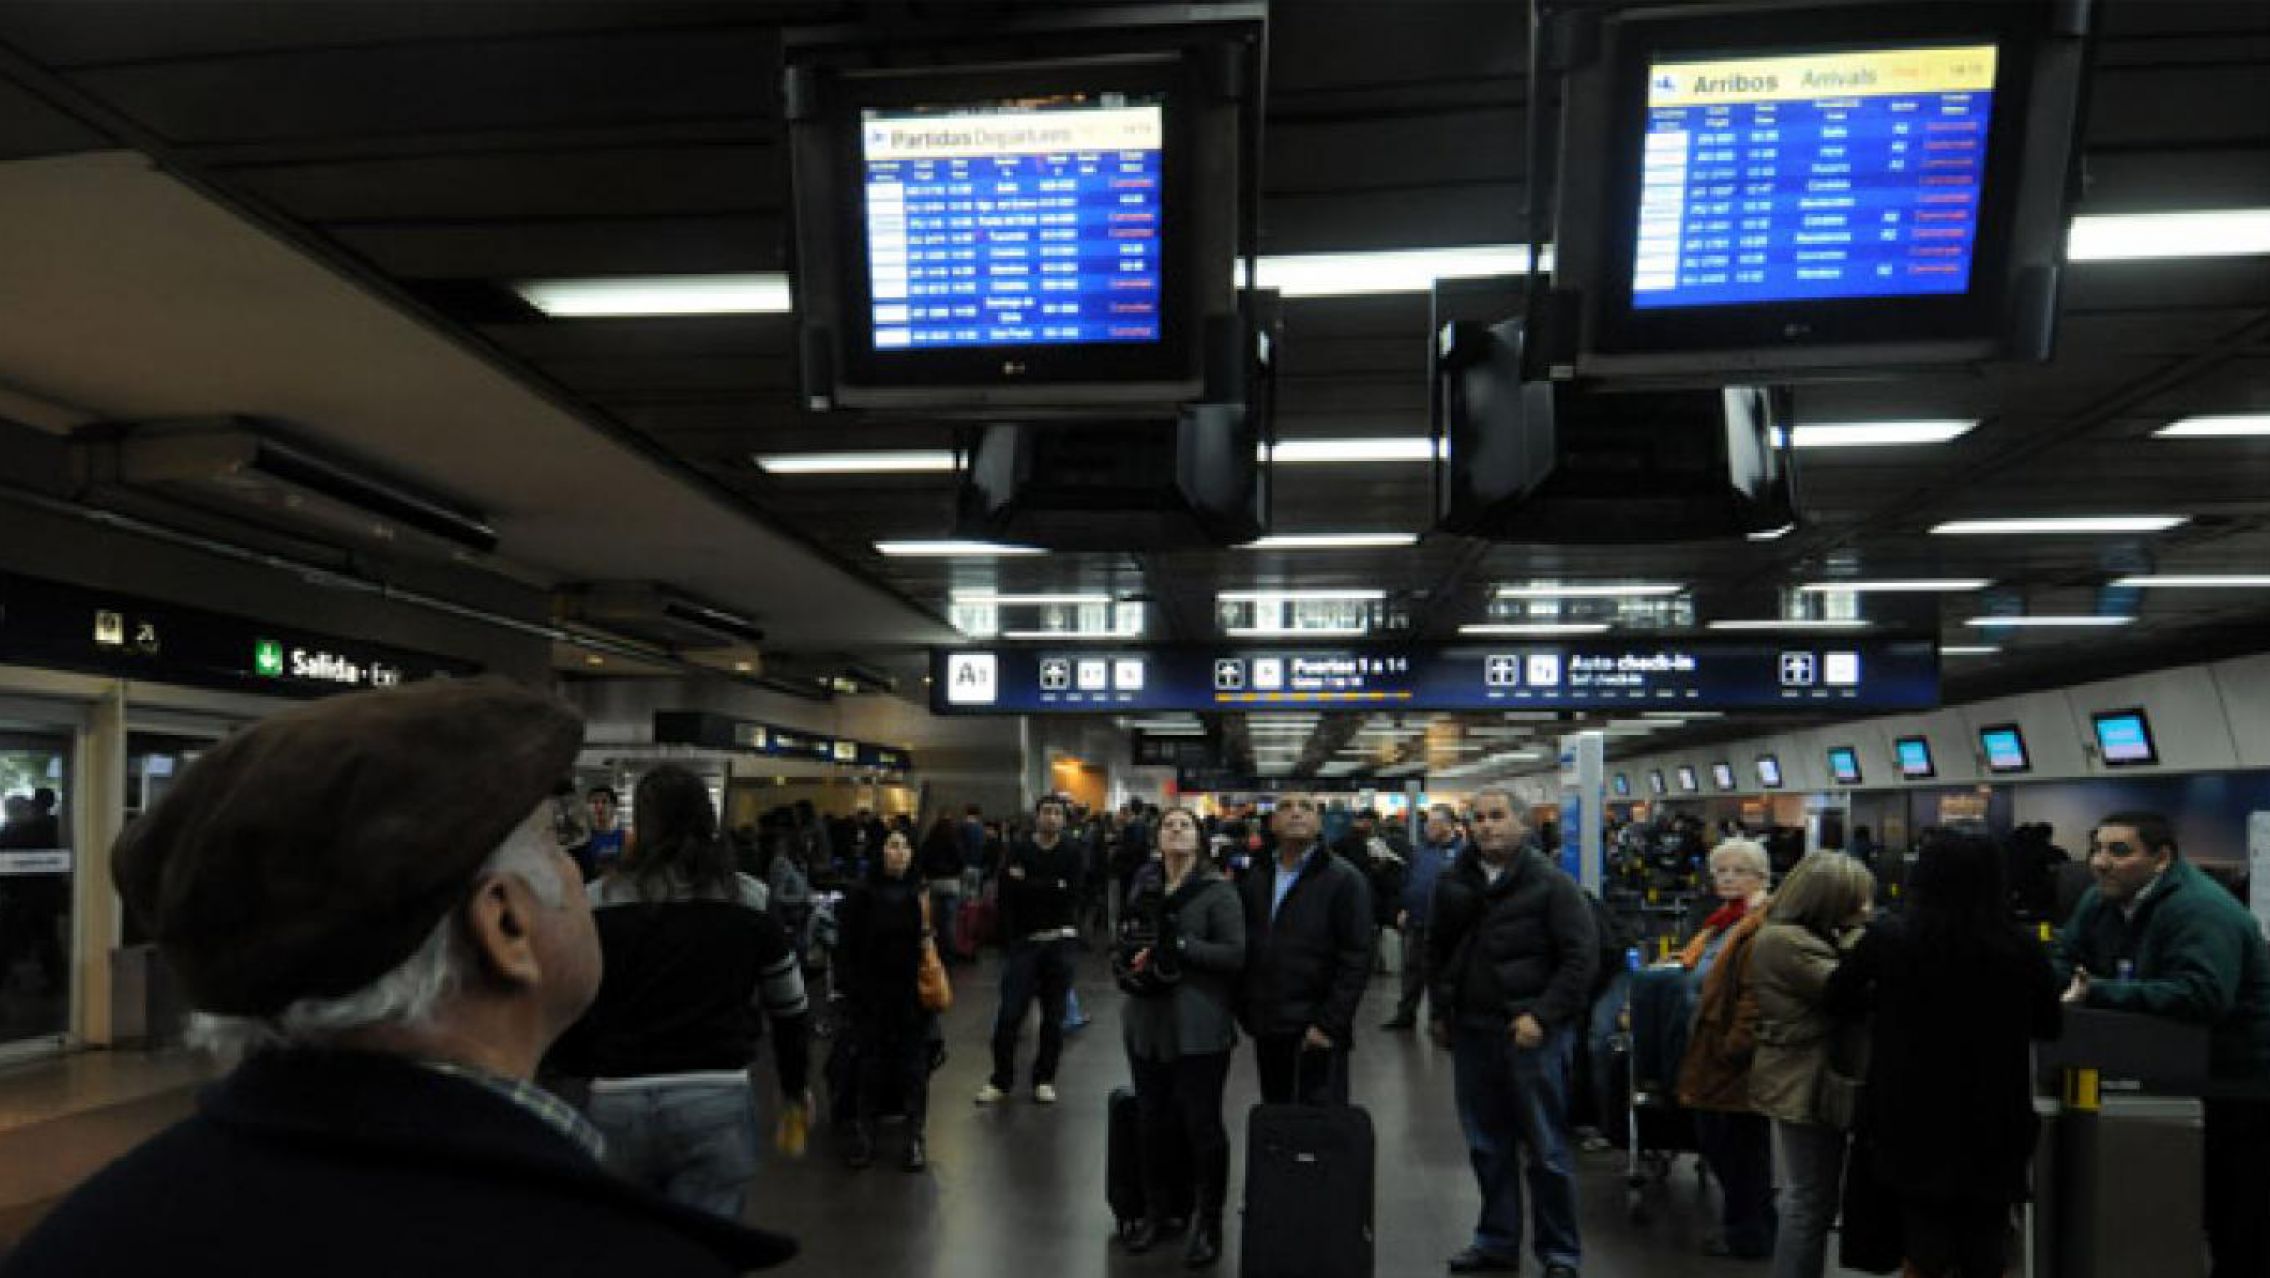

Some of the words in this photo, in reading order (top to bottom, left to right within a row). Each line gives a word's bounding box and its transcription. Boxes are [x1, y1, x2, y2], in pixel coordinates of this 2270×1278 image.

[1694, 74, 1778, 94] Arribos
[890, 127, 971, 150] Partidas
[291, 648, 360, 682] Salida
